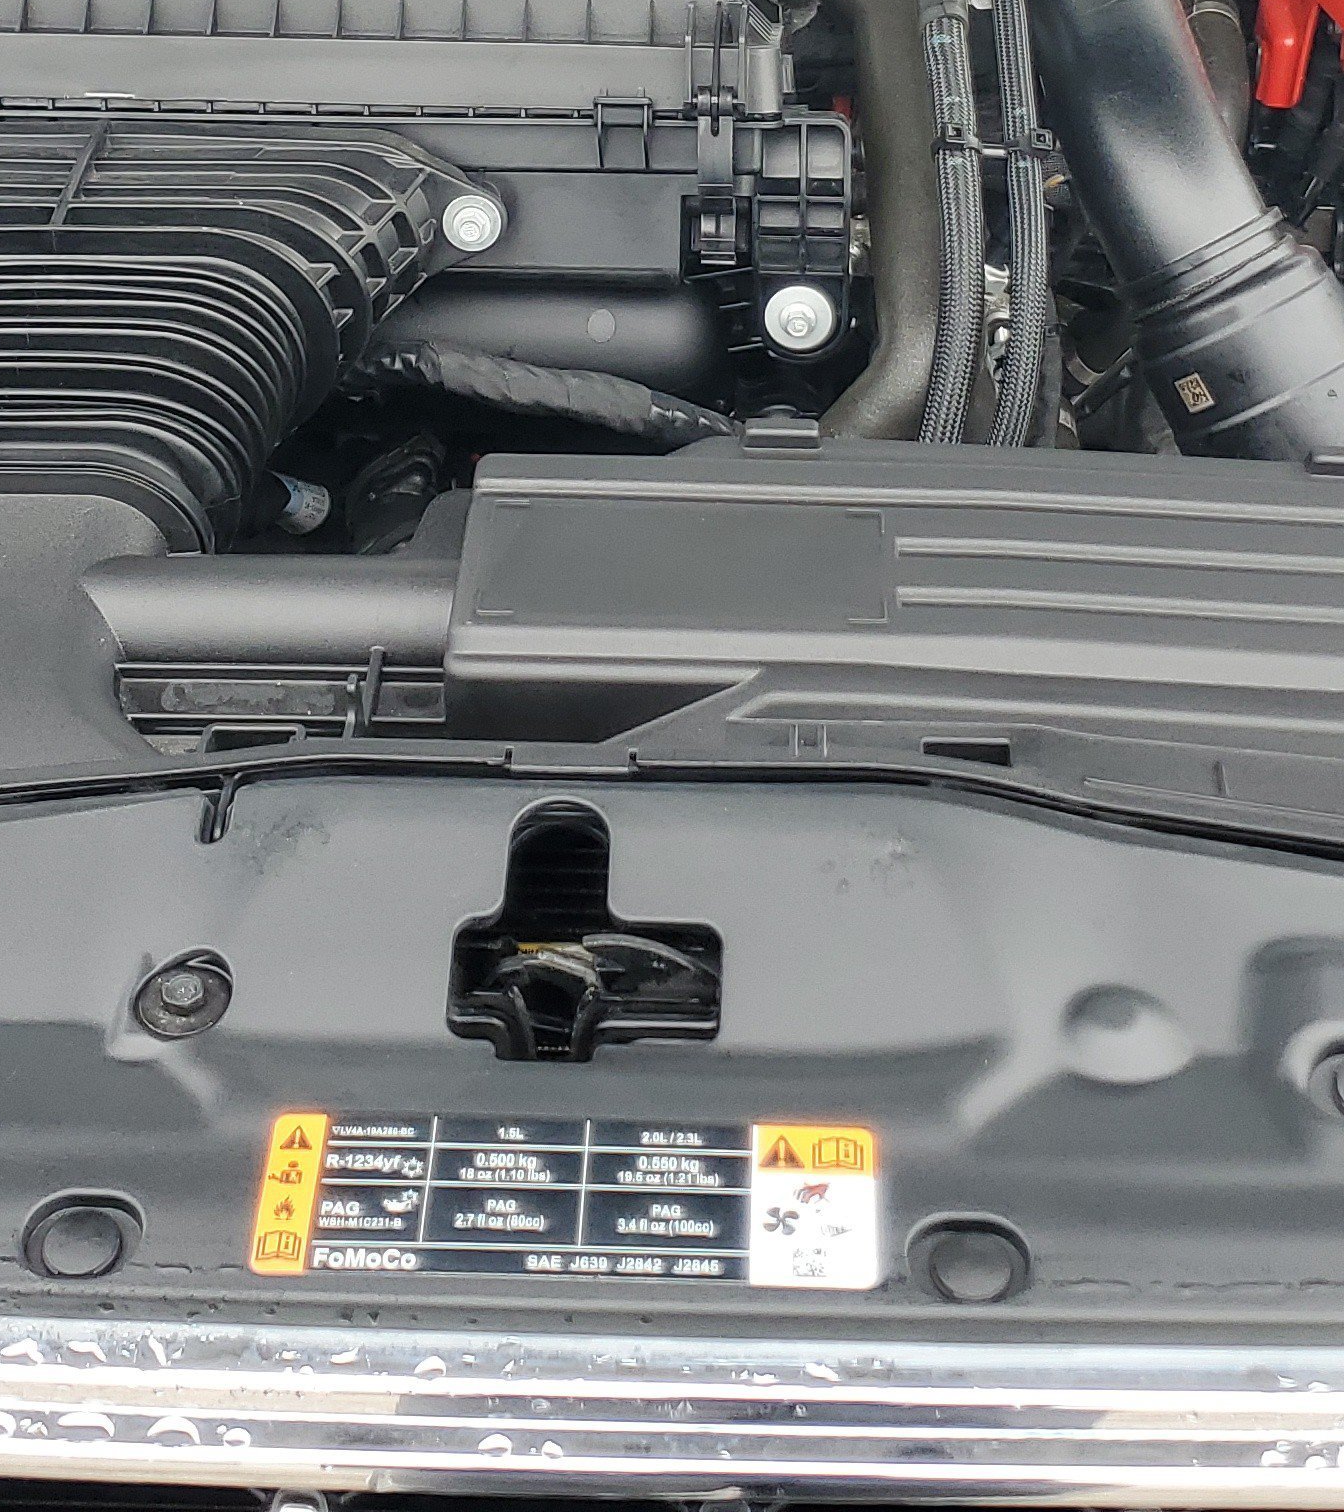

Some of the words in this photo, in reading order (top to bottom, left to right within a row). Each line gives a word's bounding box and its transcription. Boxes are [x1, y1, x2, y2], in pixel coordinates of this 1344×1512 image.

[498, 1127, 524, 1140] 1.5L
[641, 1131, 668, 1144] 2.0L
[676, 1132, 703, 1145] 2.3L
[326, 1153, 402, 1173] R-1234yf
[475, 1152, 516, 1168] 0.500
[518, 1153, 538, 1170] kg
[638, 1155, 678, 1169] 0.550
[681, 1156, 700, 1172] kg
[477, 1169, 493, 1180] oz
[495, 1168, 525, 1182] (1.10
[527, 1168, 551, 1183] lbs)
[617, 1170, 643, 1183] 19.5
[645, 1172, 661, 1183] oz
[663, 1172, 693, 1186] (1.21
[695, 1172, 719, 1187] lbs)
[320, 1200, 360, 1216] PAG
[486, 1199, 517, 1212] PAG
[651, 1204, 682, 1217] PAG
[455, 1213, 475, 1227] 2.7
[488, 1215, 504, 1227] oz
[617, 1218, 636, 1231] 3.4
[650, 1221, 666, 1232] oz
[668, 1219, 714, 1237] (100cc)
[313, 1247, 417, 1270] FoMoCo
[526, 1254, 562, 1268] SAE
